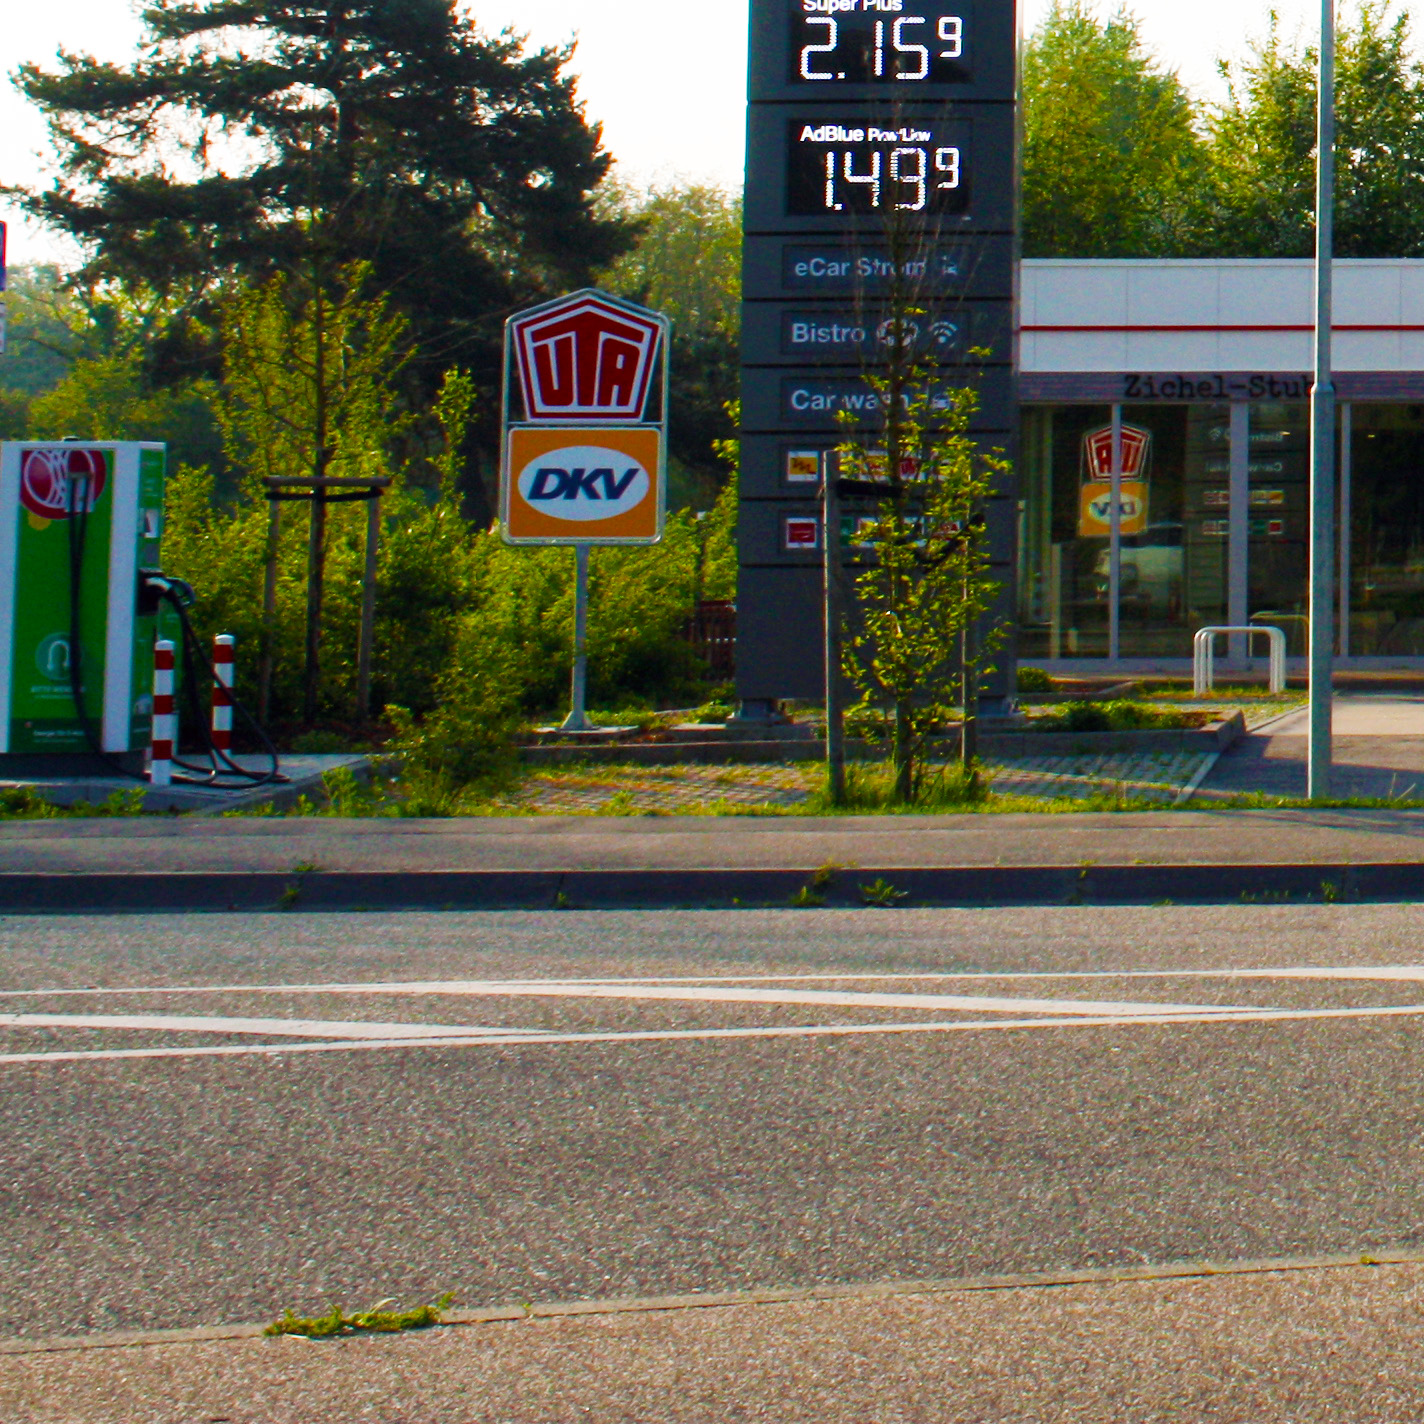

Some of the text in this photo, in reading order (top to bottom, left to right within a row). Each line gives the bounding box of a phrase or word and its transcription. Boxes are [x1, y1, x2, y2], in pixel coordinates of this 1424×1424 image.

[800, 16, 963, 80] 2.159
[800, 125, 865, 142] AdBlue
[794, 257, 850, 276] eCar
[791, 322, 866, 343] Bistro
[531, 311, 645, 407] UTA
[1124, 374, 1335, 398] Zichel-Stu
[791, 389, 836, 410] Car
[528, 468, 640, 500] DKV
